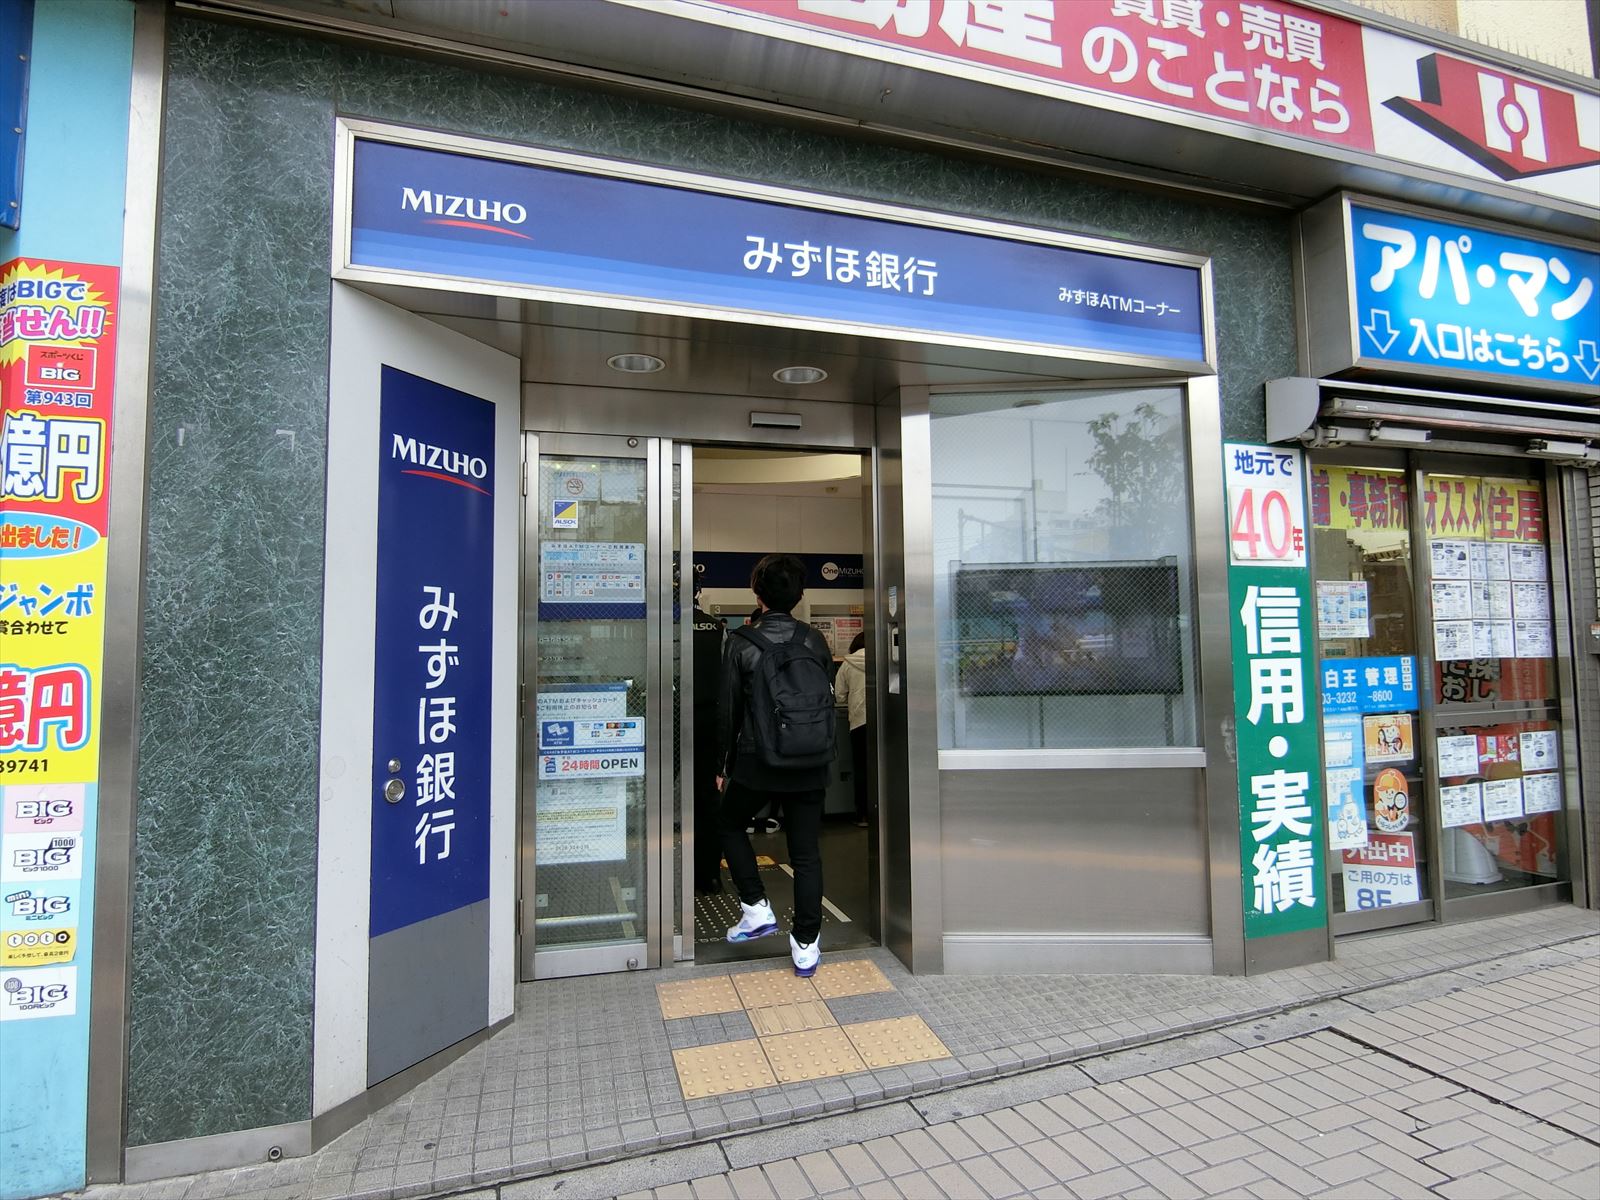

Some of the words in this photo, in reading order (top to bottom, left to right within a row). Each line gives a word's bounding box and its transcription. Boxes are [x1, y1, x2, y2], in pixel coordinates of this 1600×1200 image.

[1080, 26, 1351, 135] のことなら
[401, 187, 527, 224] MIZUHO
[743, 235, 938, 297] みずほ銀行
[1362, 222, 1594, 321] アパ・マン
[1058, 286, 1181, 314] みずほATMコーナー
[1408, 318, 1570, 373] 入口はこちら
[25, 389, 92, 408] 第943回
[1, 412, 102, 499] 億円
[392, 433, 488, 479] MIZUHO
[1234, 449, 1294, 476] 地元で
[1231, 488, 1304, 559] 40年
[0, 584, 94, 616] ジャンボ
[714, 605, 721, 614] 3
[1325, 668, 1358, 688] 白王
[415, 586, 460, 865] みずほ銀行
[1240, 585, 1316, 915] 信用・実績
[16, 800, 73, 818] BIG
[53, 838, 74, 847] 1000
[13, 848, 71, 867] BIG
[1347, 869, 1413, 886] ご用の方は
[6, 890, 30, 902] mini
[12, 896, 71, 916] BIG
[8, 931, 70, 947] toto
[9, 984, 68, 1006] BIG
